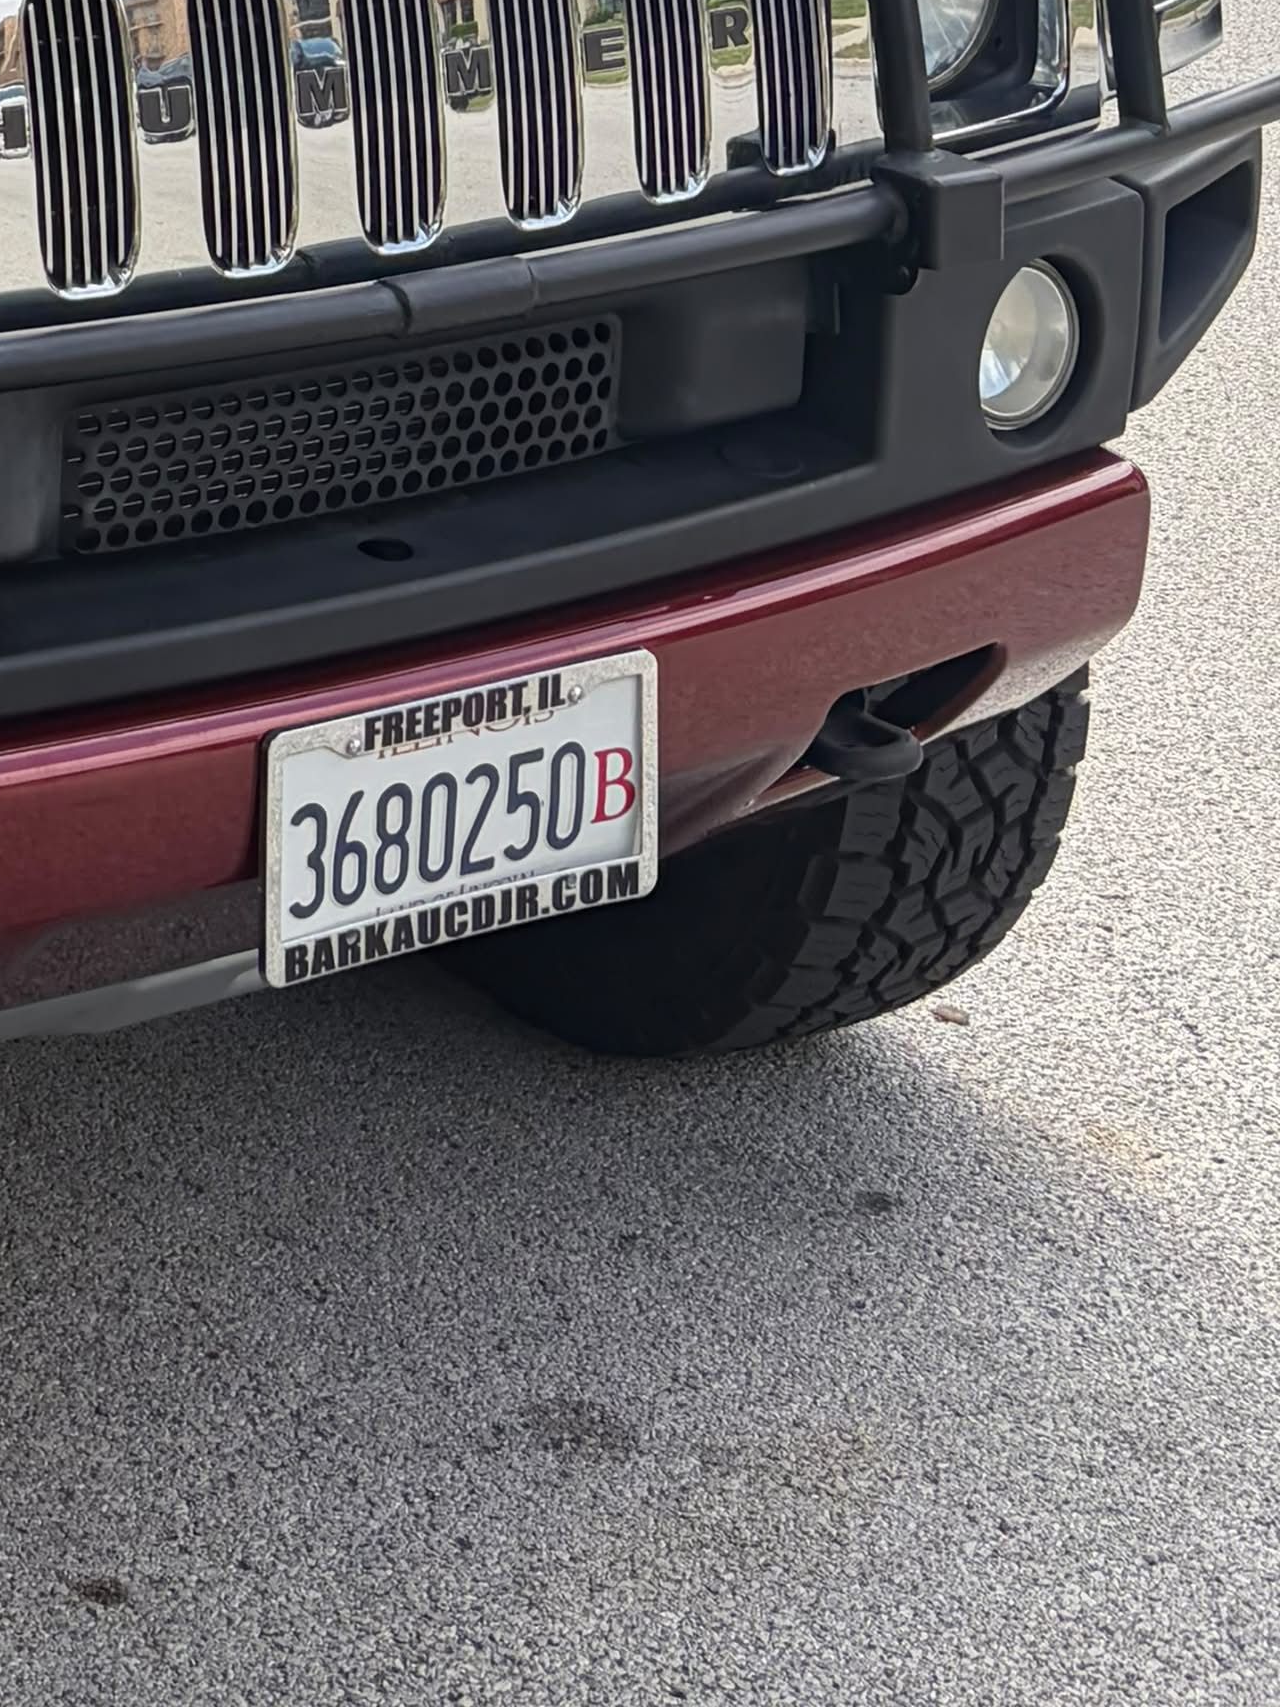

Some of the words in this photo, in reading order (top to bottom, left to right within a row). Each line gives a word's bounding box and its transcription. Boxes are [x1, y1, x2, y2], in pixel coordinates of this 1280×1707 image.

[364, 681, 532, 752] FREEPORT,
[538, 673, 566, 711] IL
[284, 862, 640, 985] BARKAUCDJR.COM
